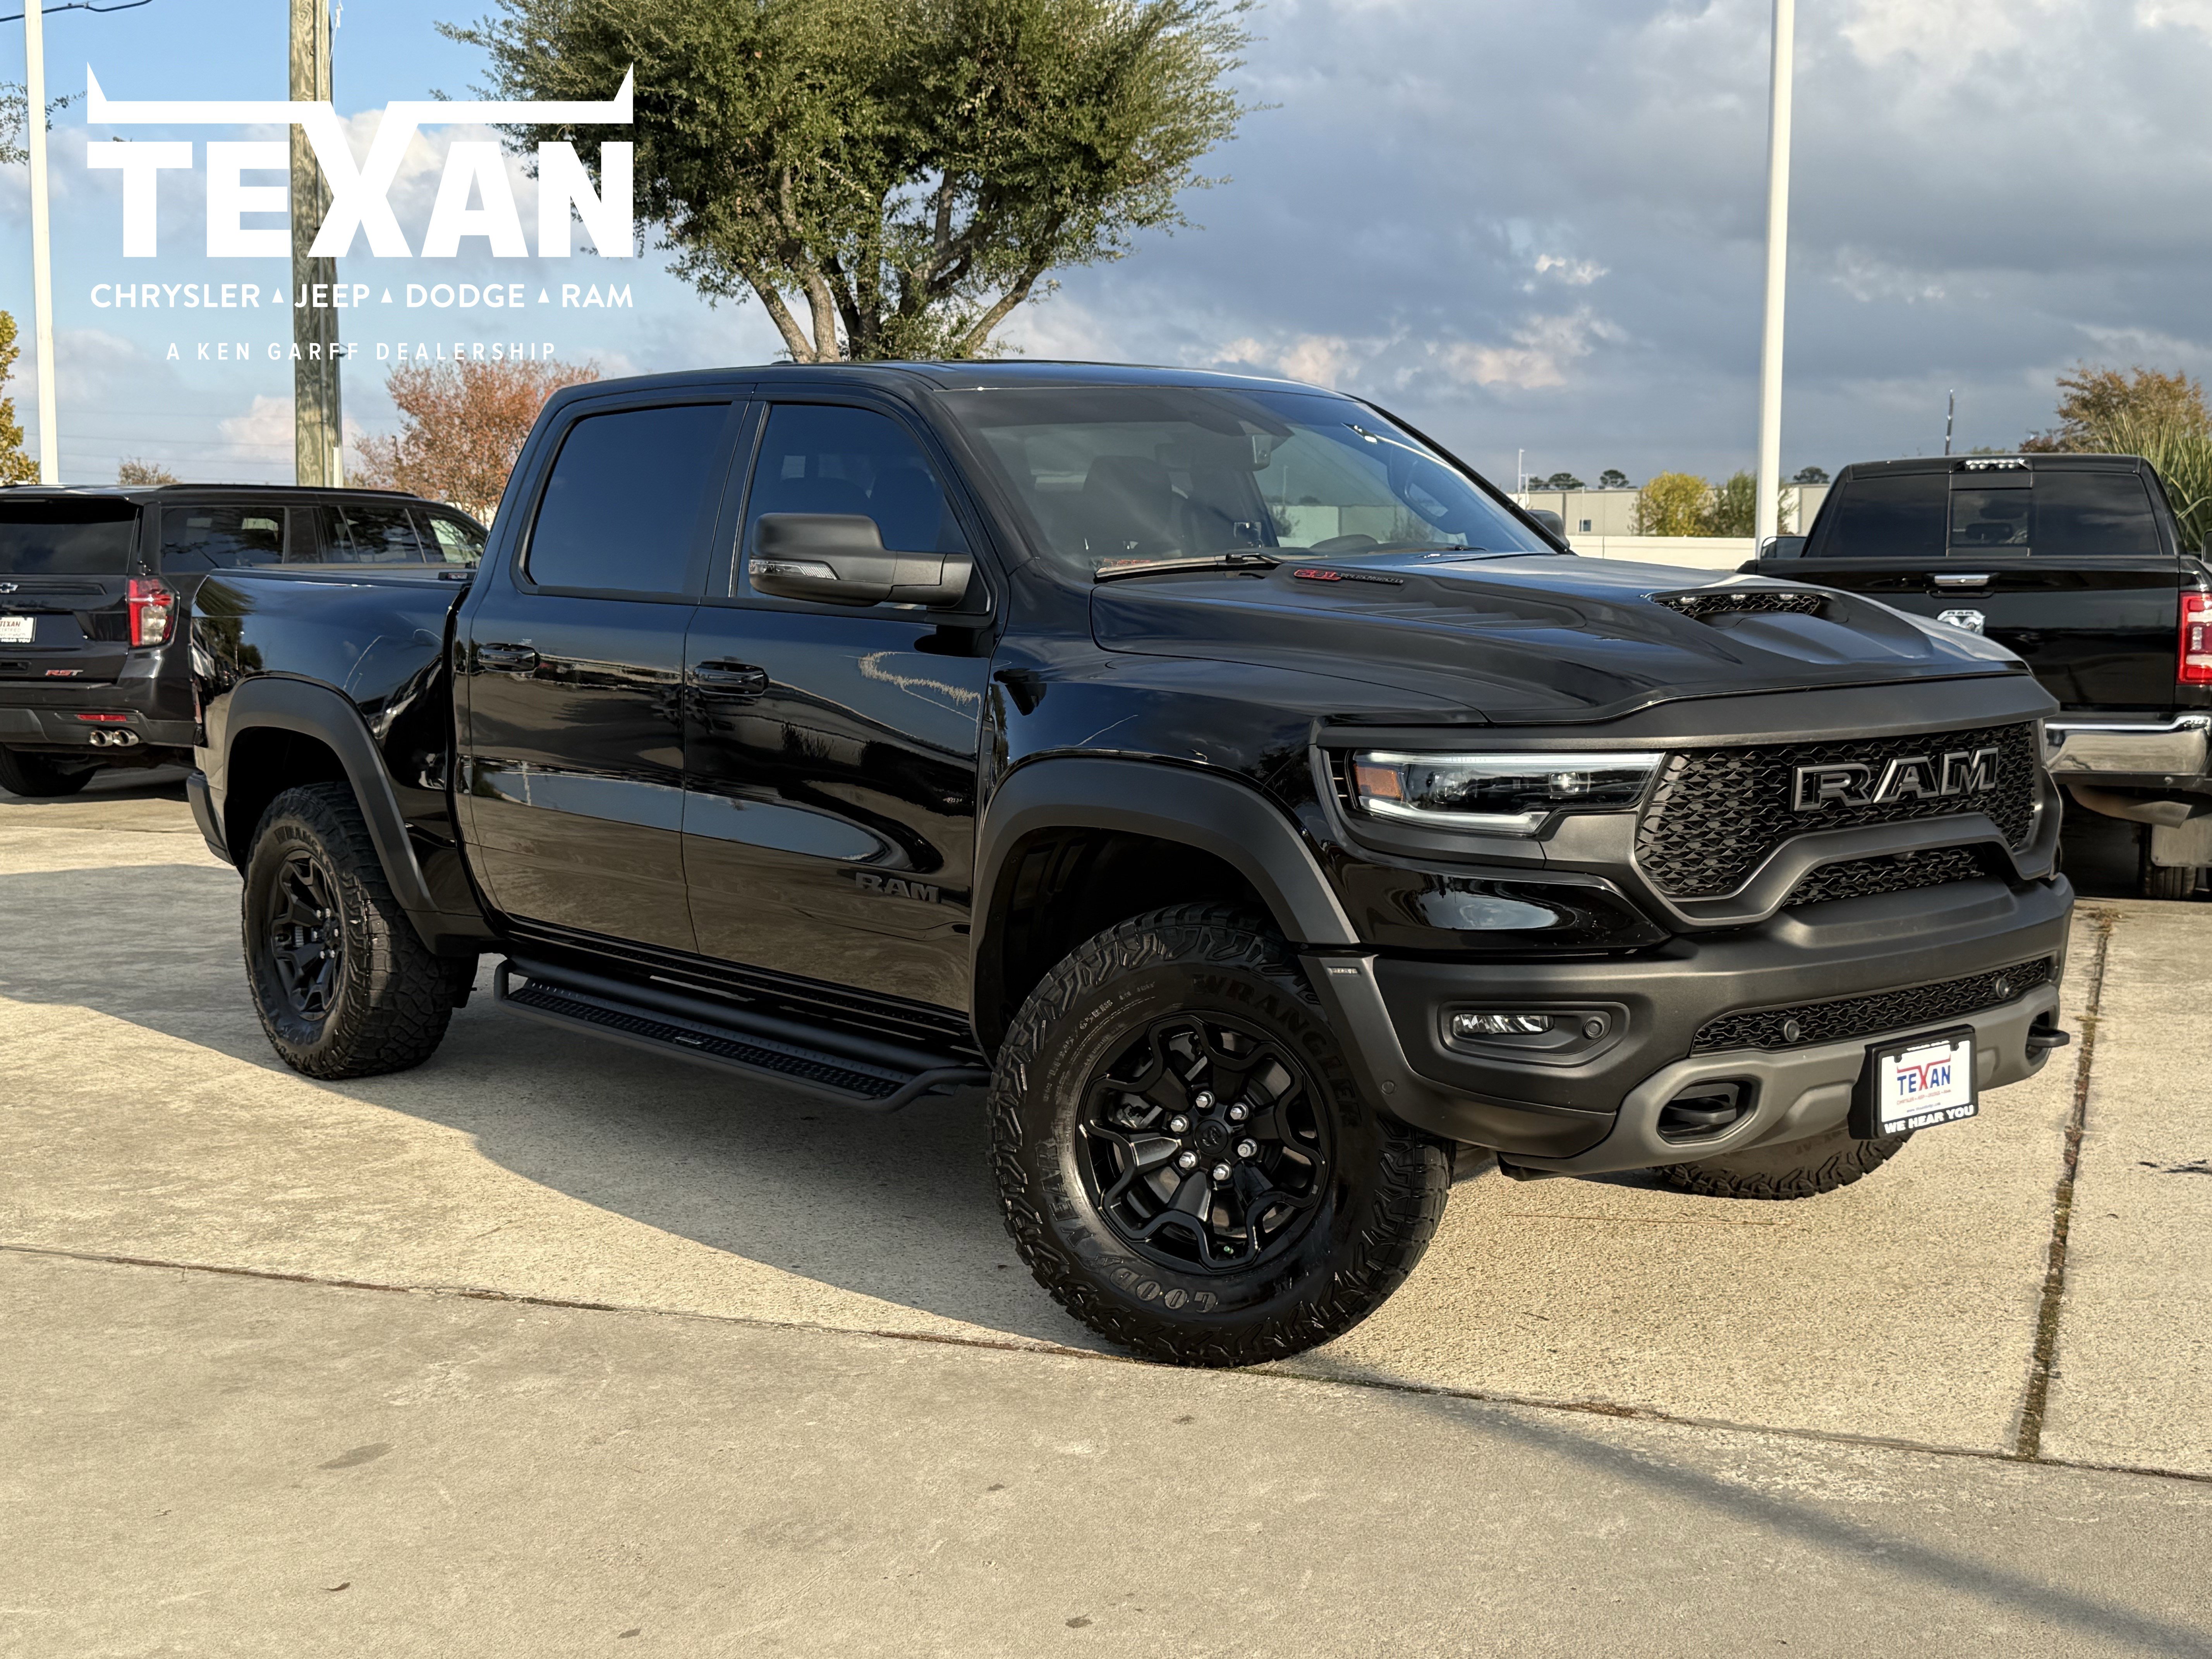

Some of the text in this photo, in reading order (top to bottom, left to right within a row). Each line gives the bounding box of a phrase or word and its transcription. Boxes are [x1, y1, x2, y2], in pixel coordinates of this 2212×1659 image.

[1790, 747, 1999, 812] RAM
[855, 872, 941, 903] RAM
[1897, 1053, 1951, 1096] TEXAN
[1884, 1120, 1906, 1134] WE
[1908, 1111, 1944, 1129] HEAR
[1946, 1104, 1974, 1120] YOU
[1035, 1137, 1218, 1313] GOODYEAR
